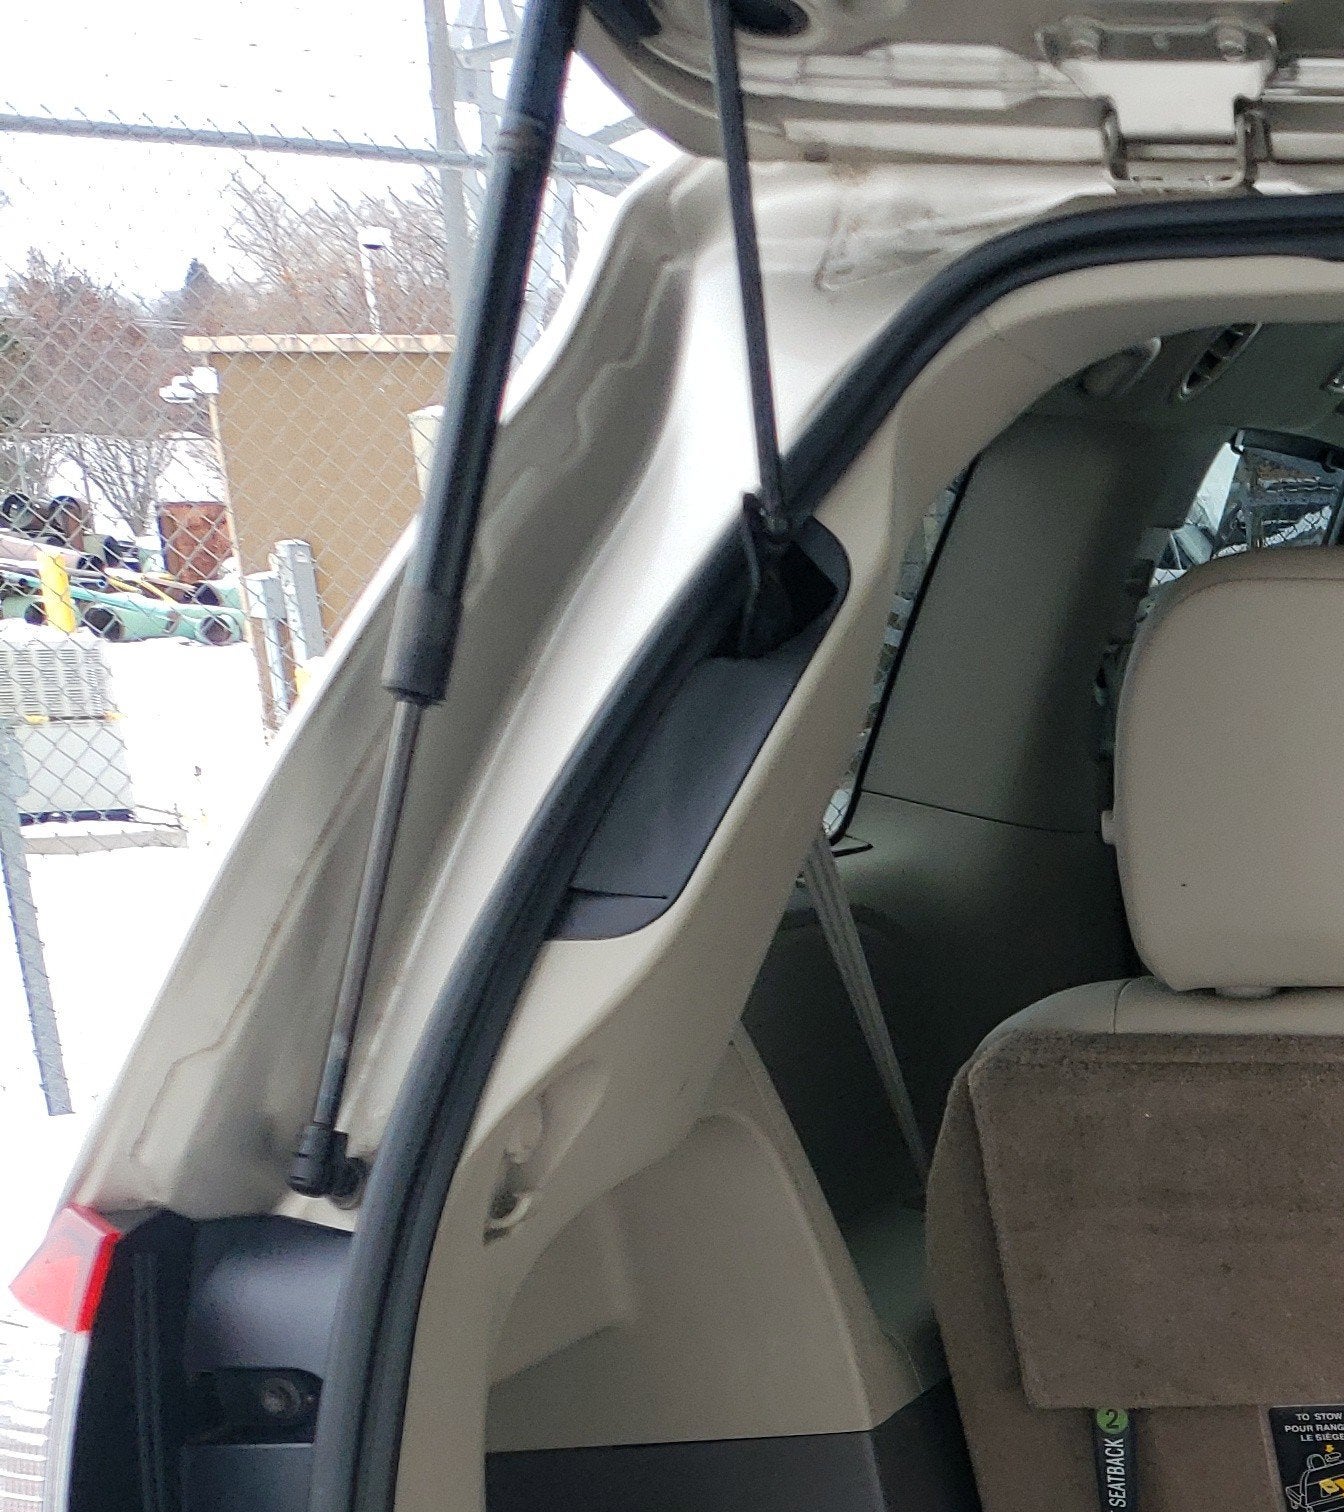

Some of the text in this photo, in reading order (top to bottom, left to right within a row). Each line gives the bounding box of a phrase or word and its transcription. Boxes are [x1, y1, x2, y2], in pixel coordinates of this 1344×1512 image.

[1106, 1409, 1119, 1429] 2
[1295, 1412, 1343, 1421] TO STOW
[1284, 1424, 1314, 1433] POUR
[1300, 1434, 1314, 1442] LE
[1104, 1438, 1127, 1508] SEATBACK
